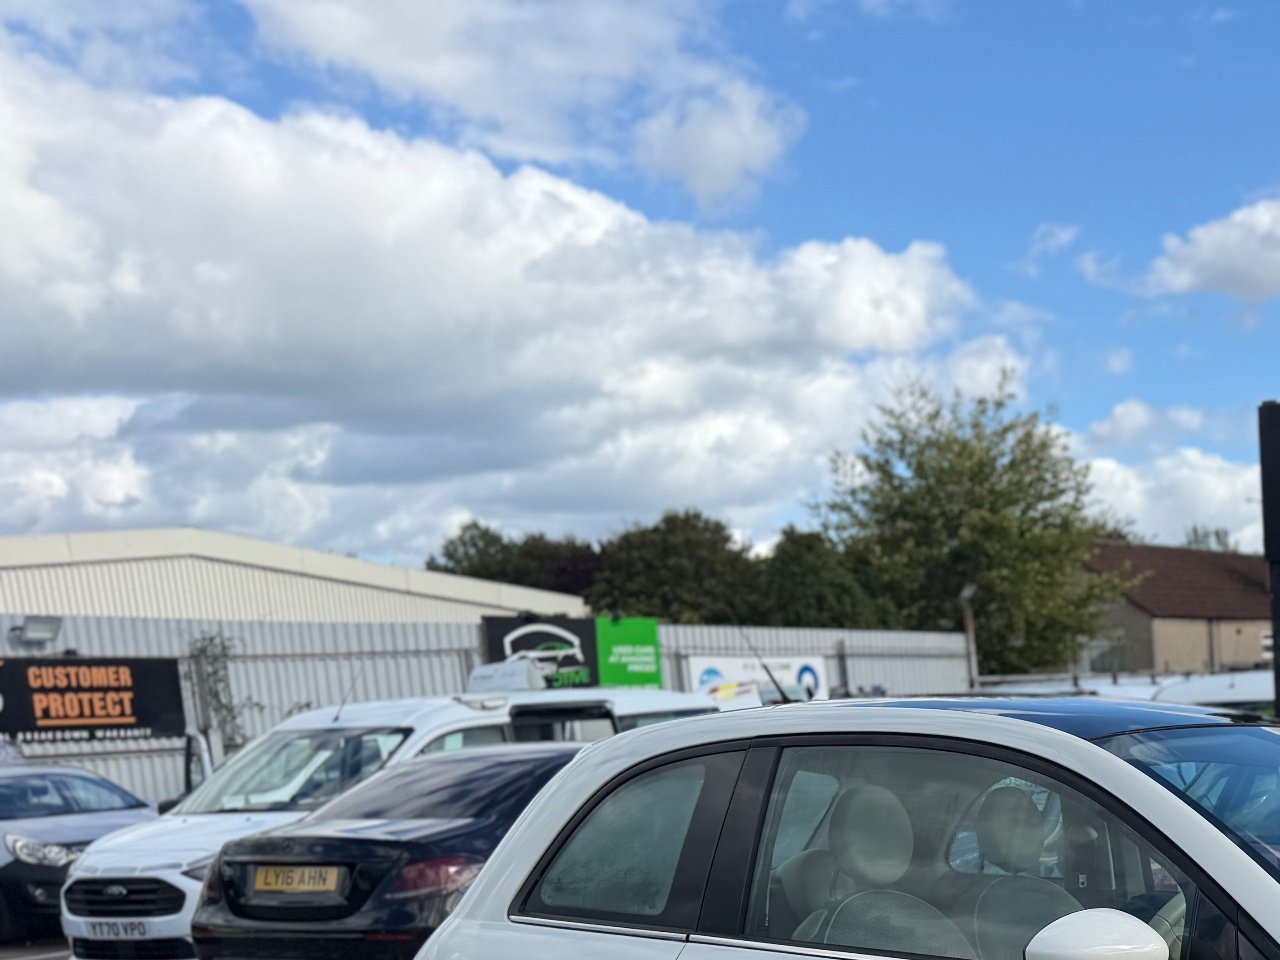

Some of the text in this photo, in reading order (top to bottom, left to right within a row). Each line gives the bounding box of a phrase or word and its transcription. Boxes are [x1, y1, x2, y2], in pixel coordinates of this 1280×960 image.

[27, 666, 133, 688] CUSTOMER
[33, 692, 134, 718] PROTECT
[263, 868, 328, 887] LY16 AHN
